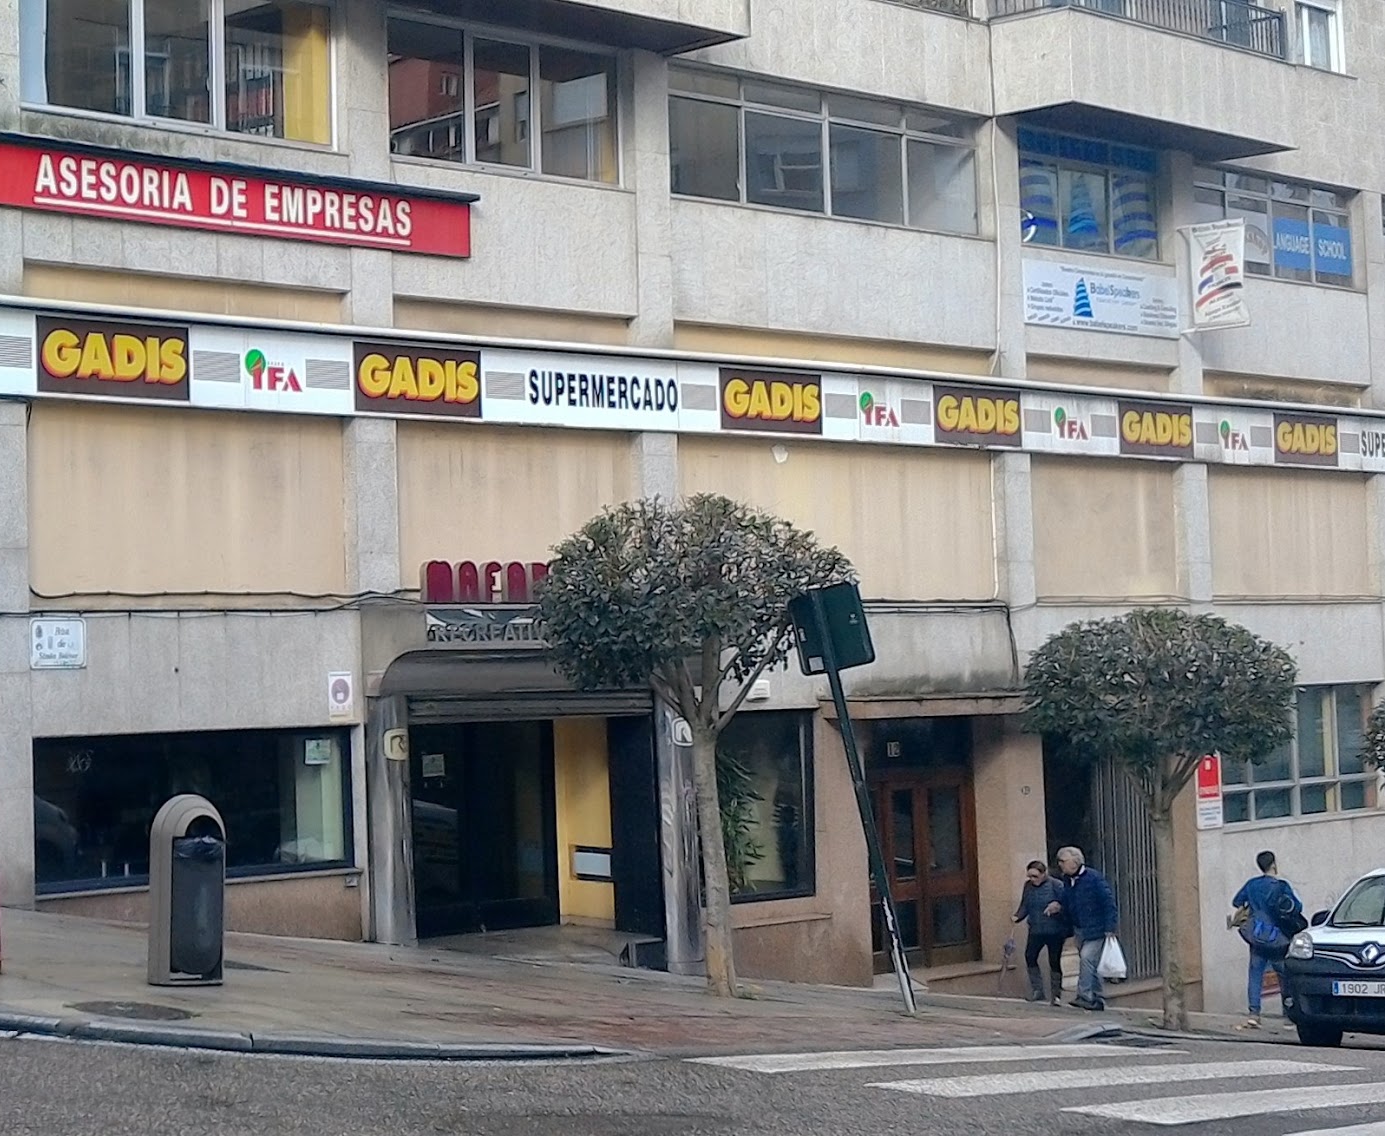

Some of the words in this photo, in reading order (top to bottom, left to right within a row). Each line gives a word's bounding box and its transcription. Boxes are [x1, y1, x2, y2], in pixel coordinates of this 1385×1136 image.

[33, 153, 194, 213] ASESORIA
[209, 176, 249, 218] DE
[263, 183, 412, 238] EMPRESAS
[1273, 232, 1310, 255] LANGUAGE
[1318, 238, 1348, 261] SCHOOL
[41, 328, 188, 385] GADIS
[357, 352, 480, 405] GADIS
[528, 368, 679, 413] SUPERMERCADO
[722, 378, 822, 423] GADIS
[936, 394, 1021, 436] GADIS
[1121, 408, 1193, 450] GADIS
[1276, 420, 1337, 457] GADIS
[434, 622, 550, 644] RECREATIV
[1342, 983, 1369, 995] 1902
